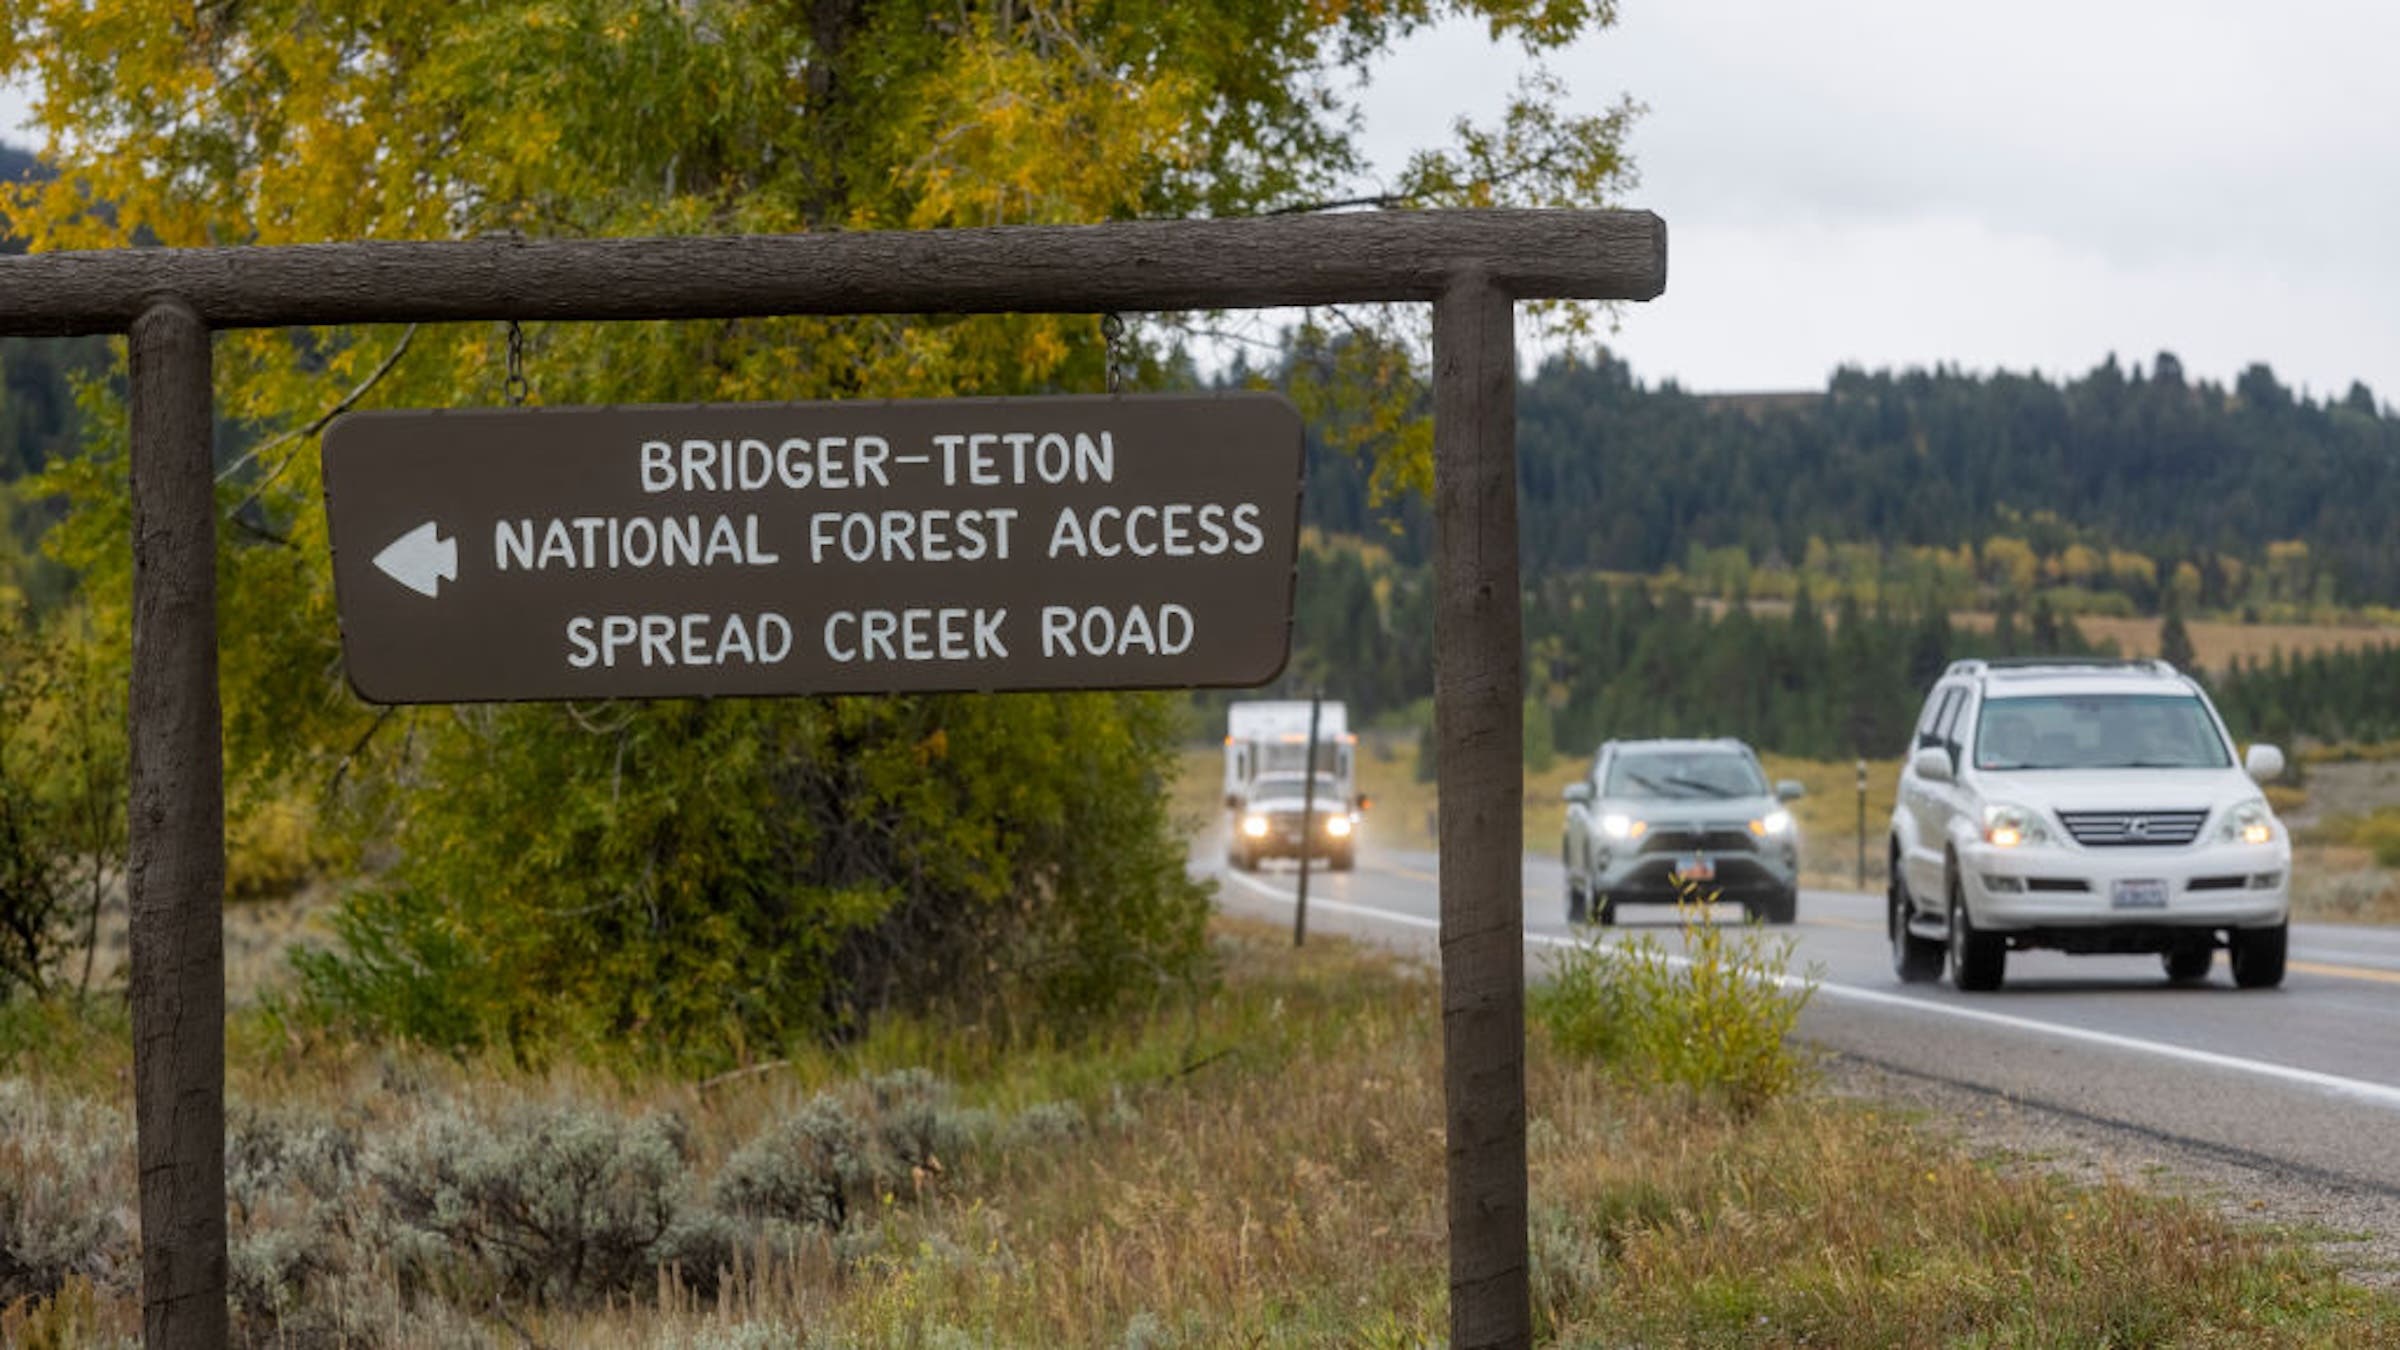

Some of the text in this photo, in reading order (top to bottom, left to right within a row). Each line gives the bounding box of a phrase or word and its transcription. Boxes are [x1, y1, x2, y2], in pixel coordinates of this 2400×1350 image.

[641, 431, 1114, 492] BRIDGER-TETON
[495, 503, 1264, 570] NATIONAL FOREST ACCESS
[566, 604, 1194, 667] SPREAD CREEK ROAD
